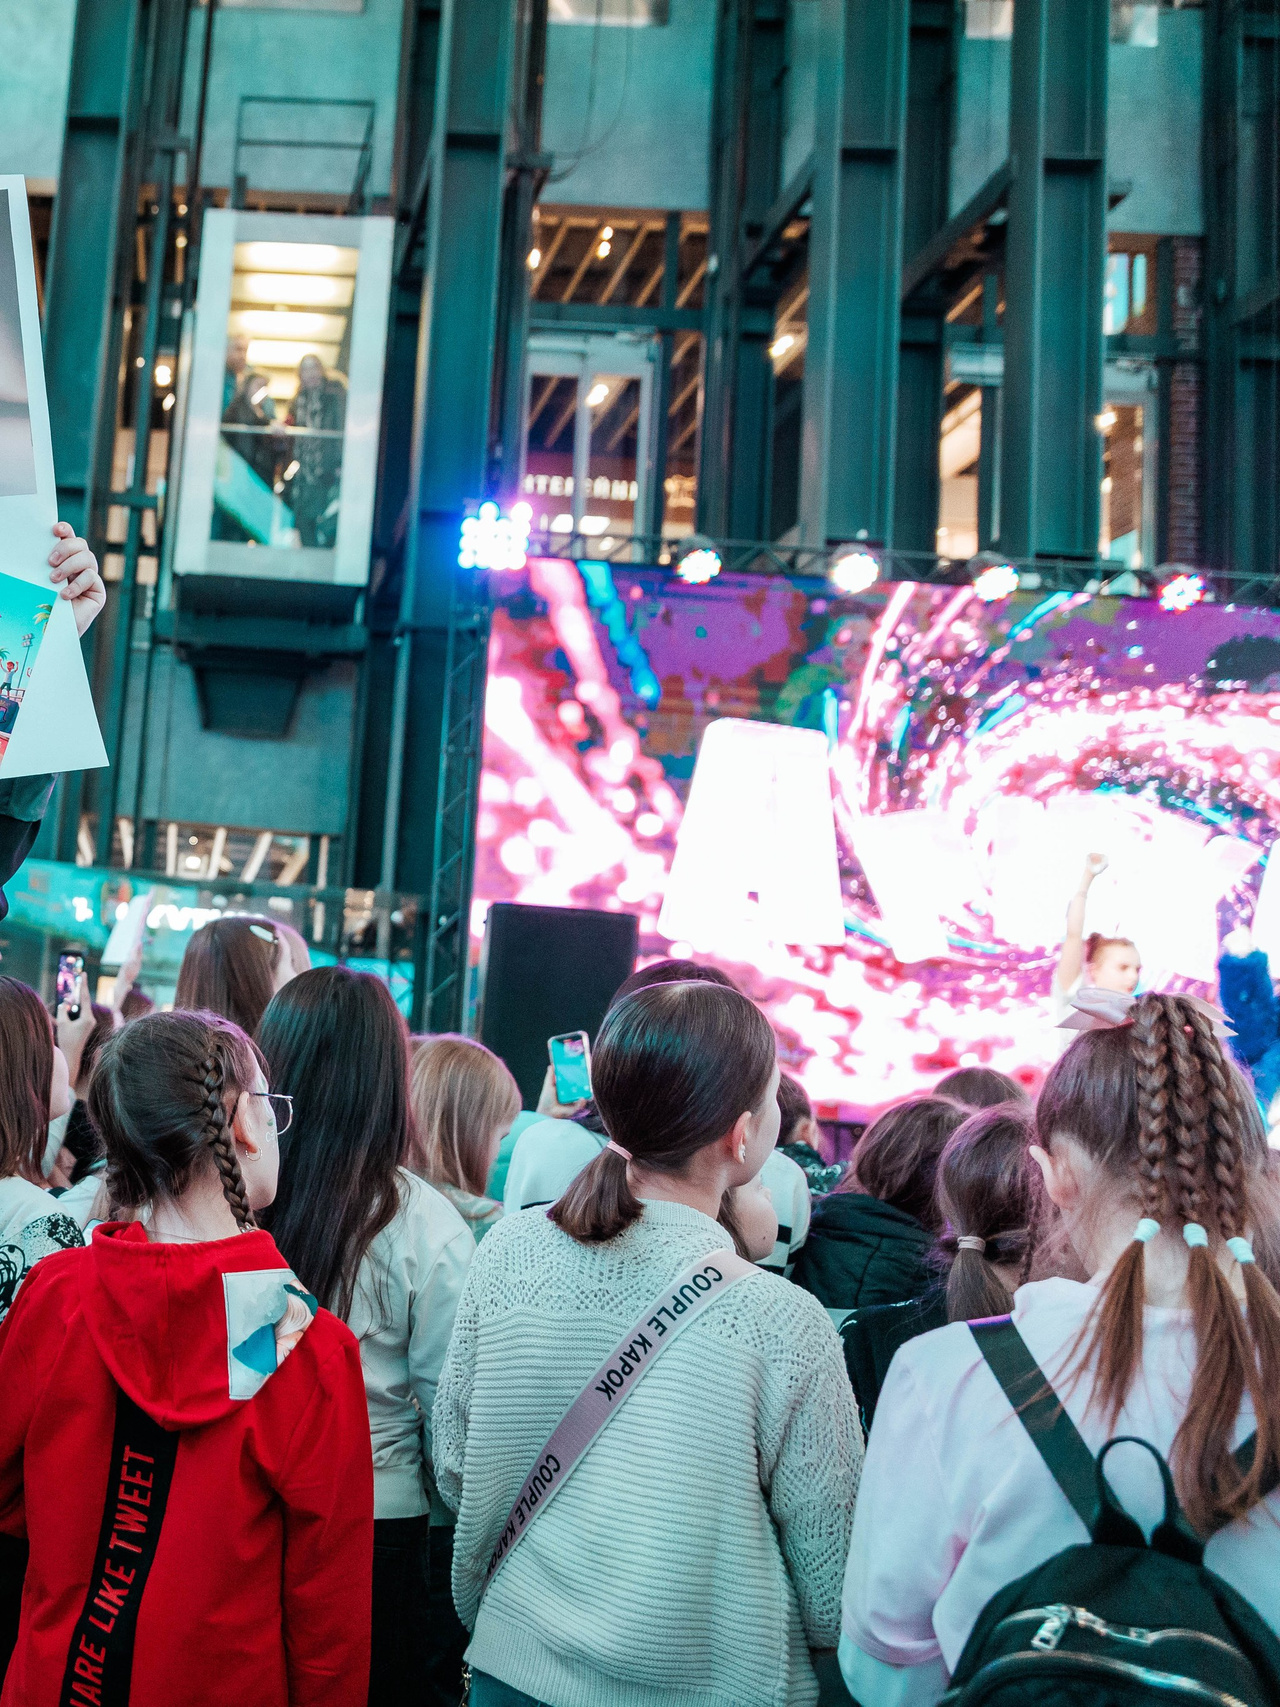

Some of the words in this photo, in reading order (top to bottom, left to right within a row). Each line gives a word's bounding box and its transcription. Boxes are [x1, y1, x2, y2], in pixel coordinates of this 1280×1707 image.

[646, 1265, 723, 1337] COUPLE
[594, 1332, 653, 1402] KAPOK
[108, 1444, 155, 1554] TWEET
[514, 1453, 561, 1526] COUPLE
[88, 1558, 136, 1634] LIKE
[69, 1633, 107, 1707] ARE
